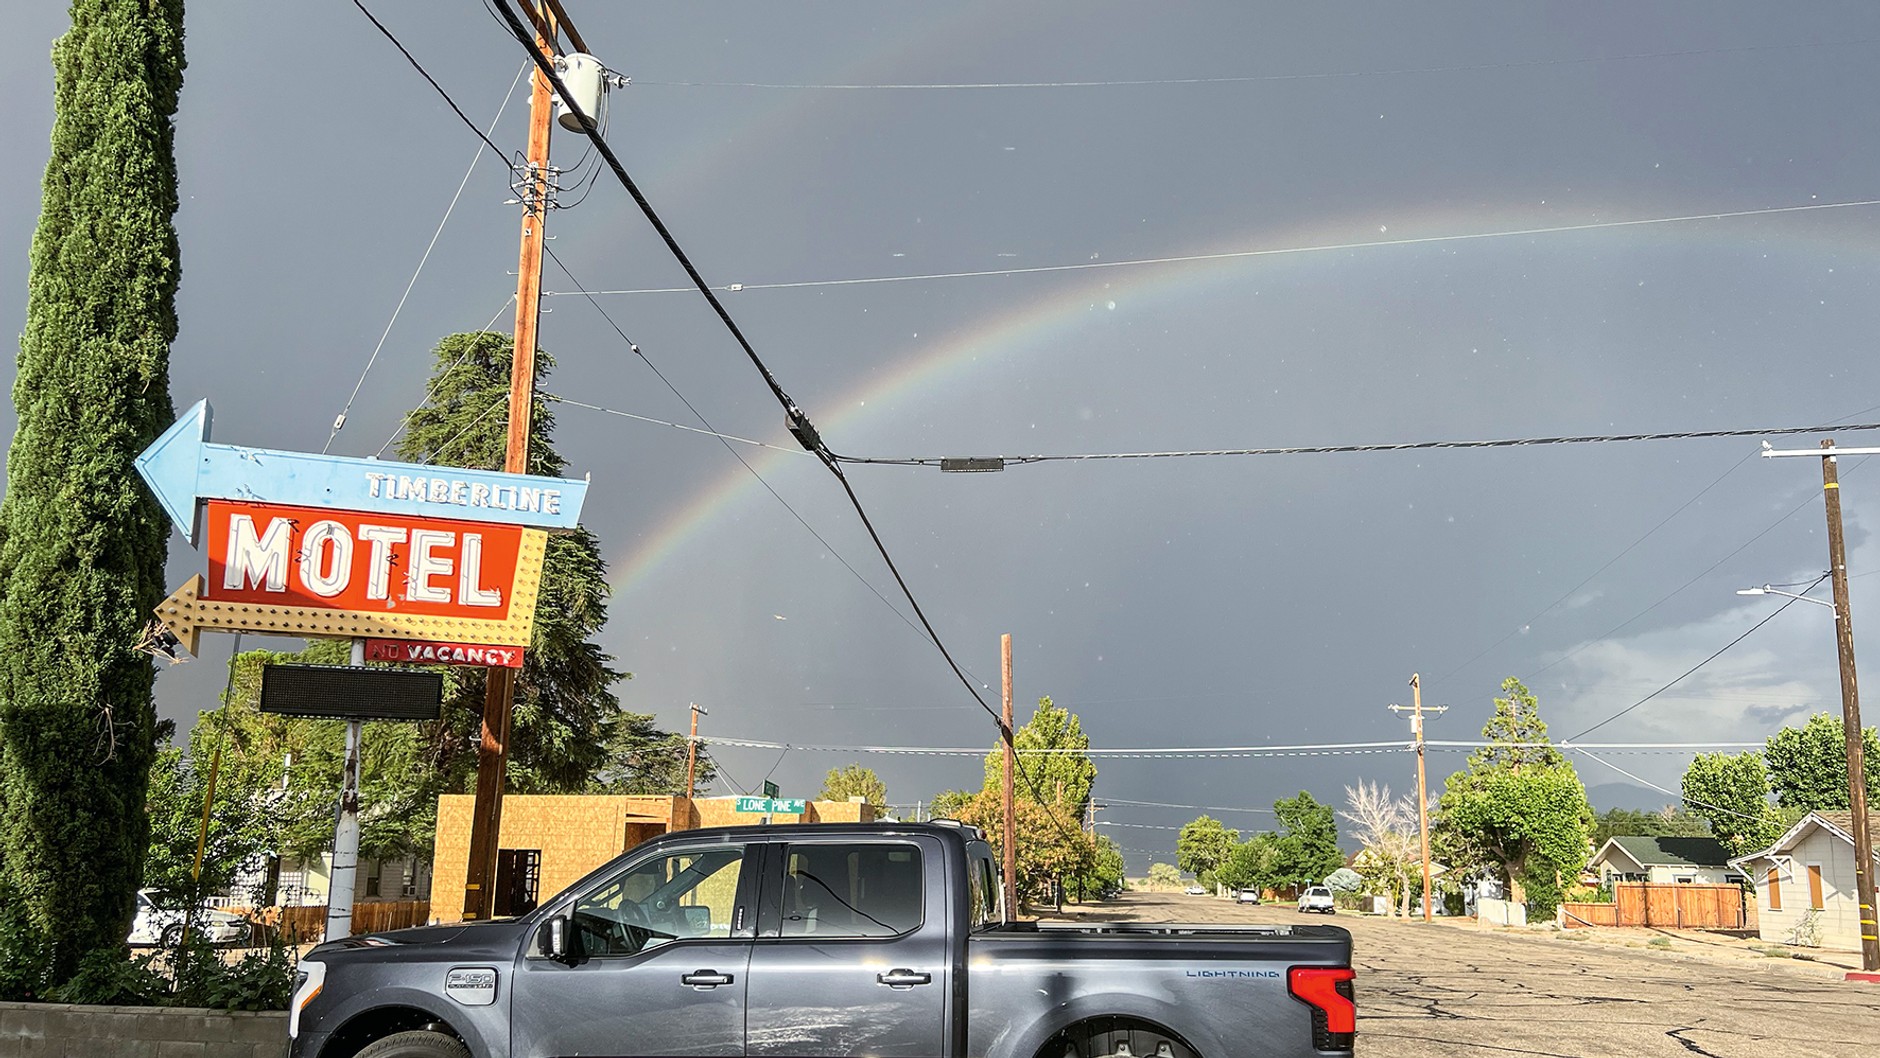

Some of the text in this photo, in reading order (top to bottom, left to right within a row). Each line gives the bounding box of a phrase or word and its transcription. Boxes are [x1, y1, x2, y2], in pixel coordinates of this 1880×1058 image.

[366, 472, 561, 515] TIMBERLINE
[223, 513, 502, 607] MOTEL
[373, 644, 516, 665] NO VACANCY
[737, 798, 741, 806] S
[743, 800, 766, 811] LONE
[772, 800, 792, 812] PINE
